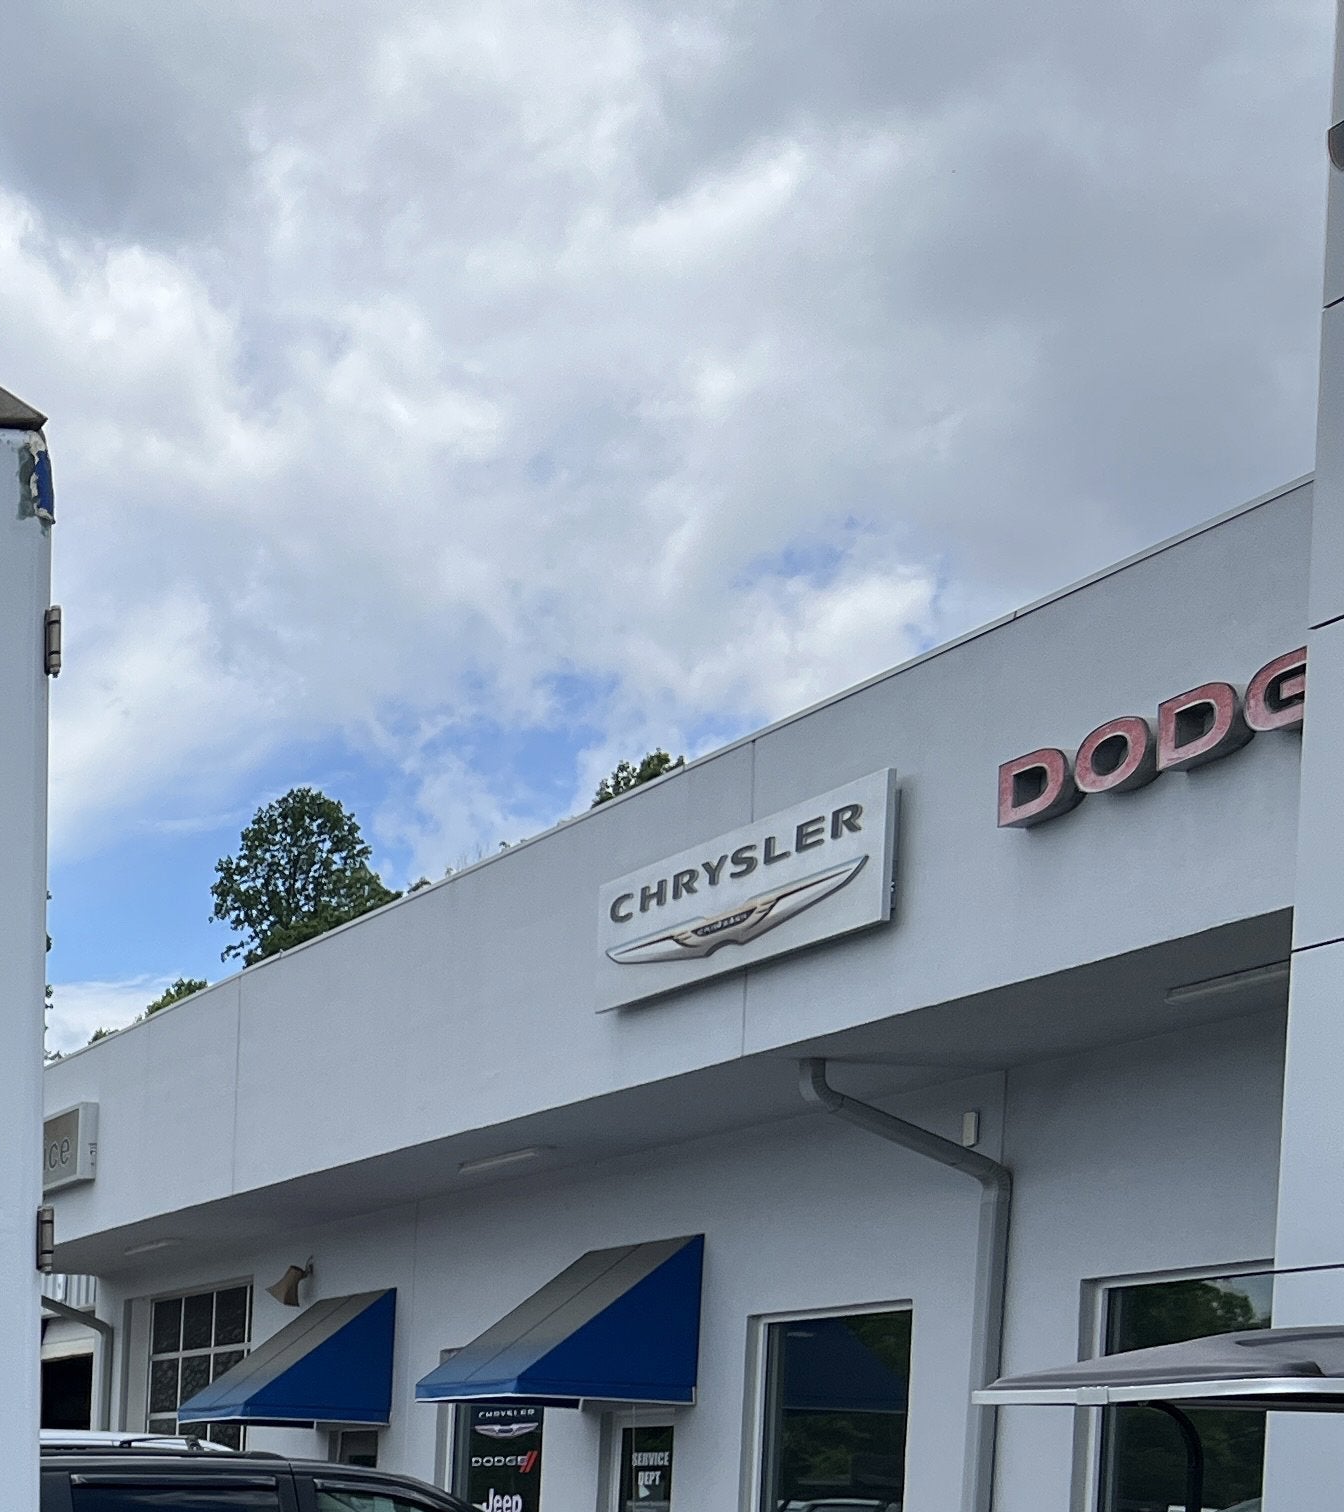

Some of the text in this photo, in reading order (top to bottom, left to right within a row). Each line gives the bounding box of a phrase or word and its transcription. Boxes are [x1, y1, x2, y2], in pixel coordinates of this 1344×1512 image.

[610, 803, 864, 924] CHRYSLER
[472, 1455, 528, 1467] DODGE
[631, 1451, 670, 1466] SERVICE
[638, 1470, 661, 1486] DEPT
